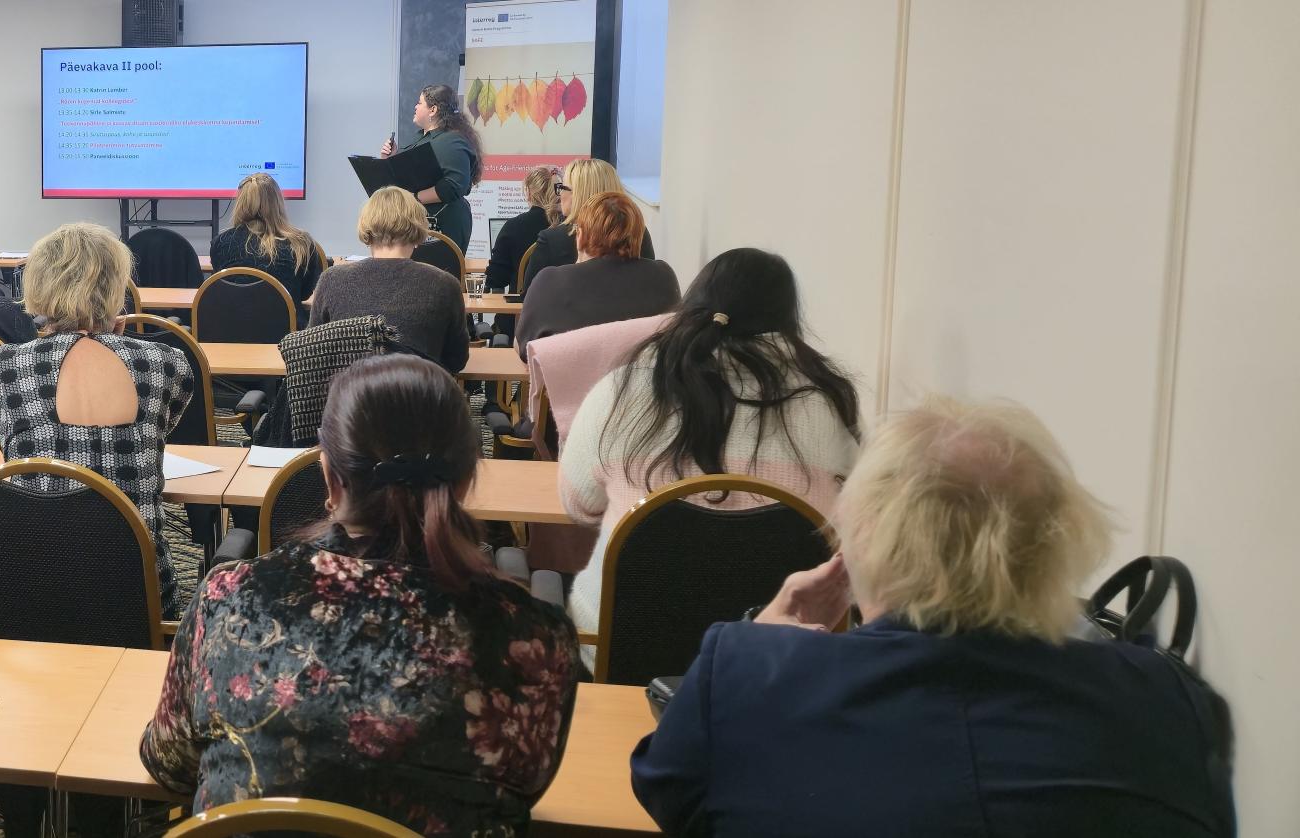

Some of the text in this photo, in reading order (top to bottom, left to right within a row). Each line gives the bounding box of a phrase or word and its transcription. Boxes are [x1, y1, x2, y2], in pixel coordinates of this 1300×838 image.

[60, 60, 162, 73] Päevakava II pool:
